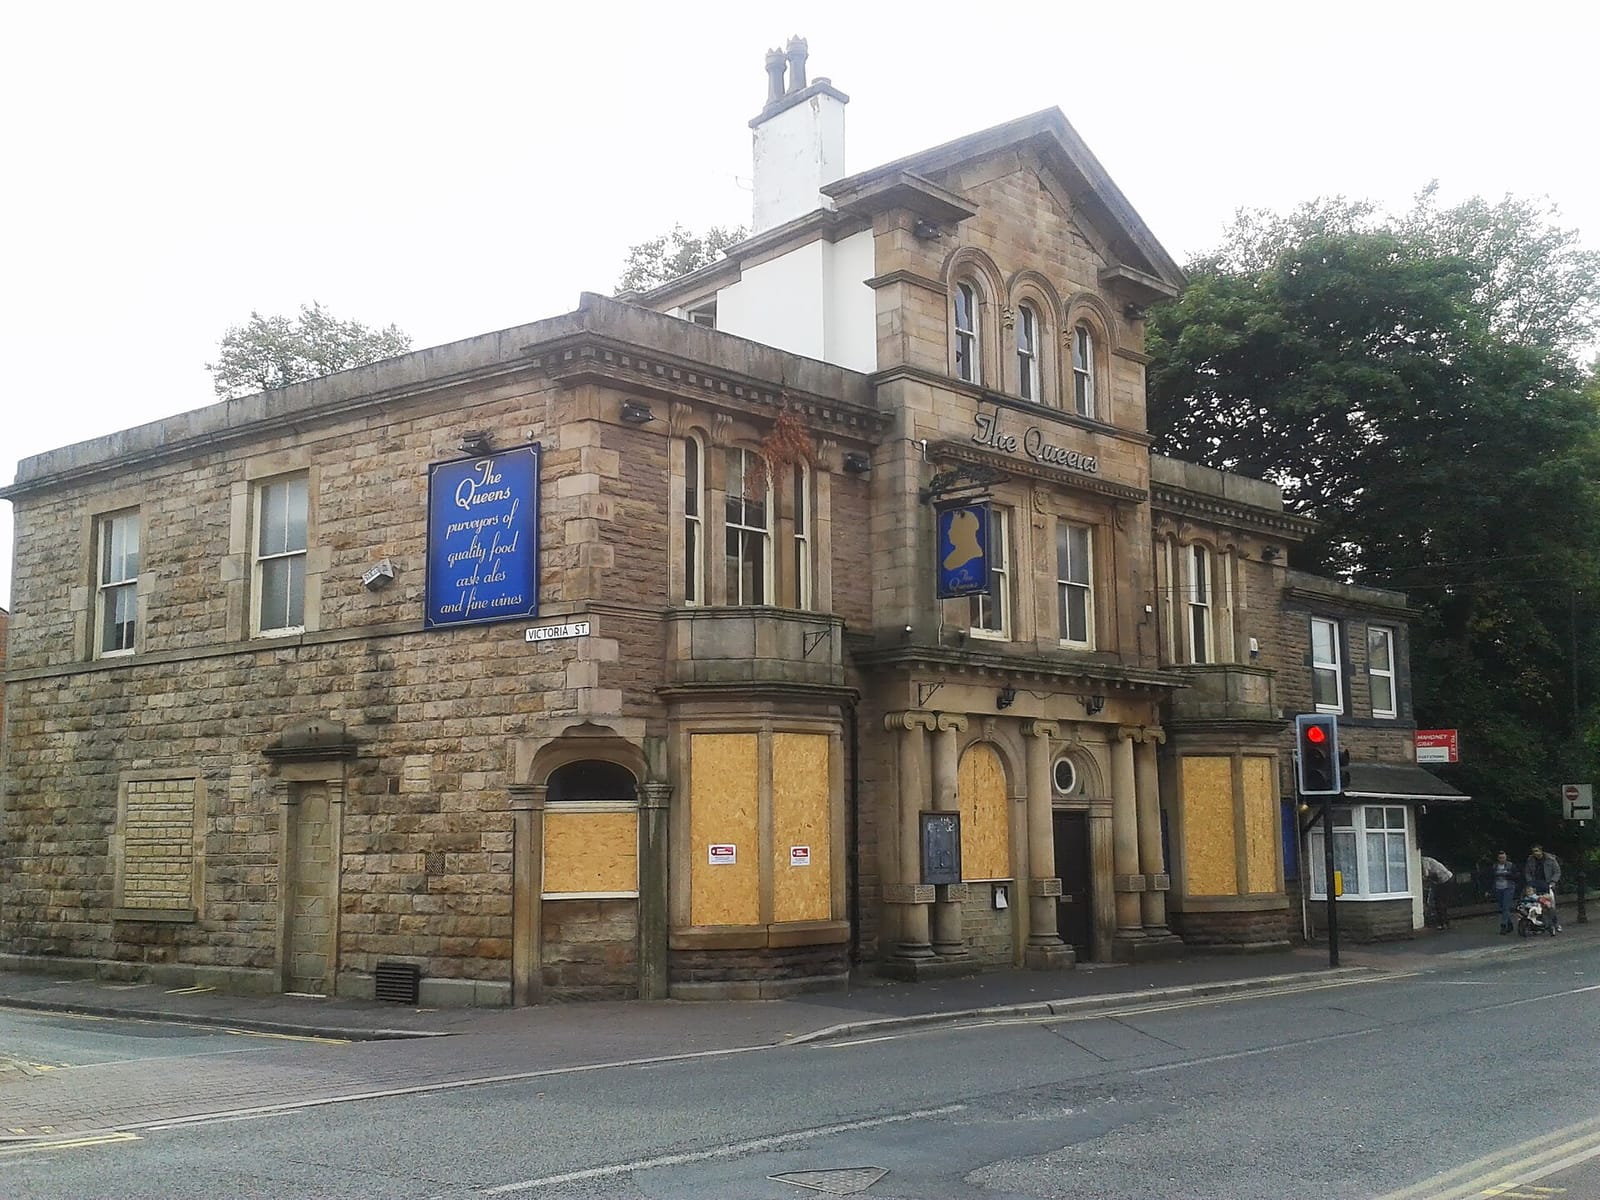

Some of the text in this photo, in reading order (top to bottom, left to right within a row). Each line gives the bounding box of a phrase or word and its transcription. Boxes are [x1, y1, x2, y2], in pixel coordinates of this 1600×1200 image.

[972, 407, 1098, 473] The Queens
[474, 459, 502, 487] The
[455, 478, 511, 511] Queens
[445, 498, 520, 540] purveyors of
[447, 530, 519, 568] quality food
[456, 558, 506, 587] cask ales
[440, 586, 522, 617] and fine wines
[528, 625, 568, 640] VICTORIA
